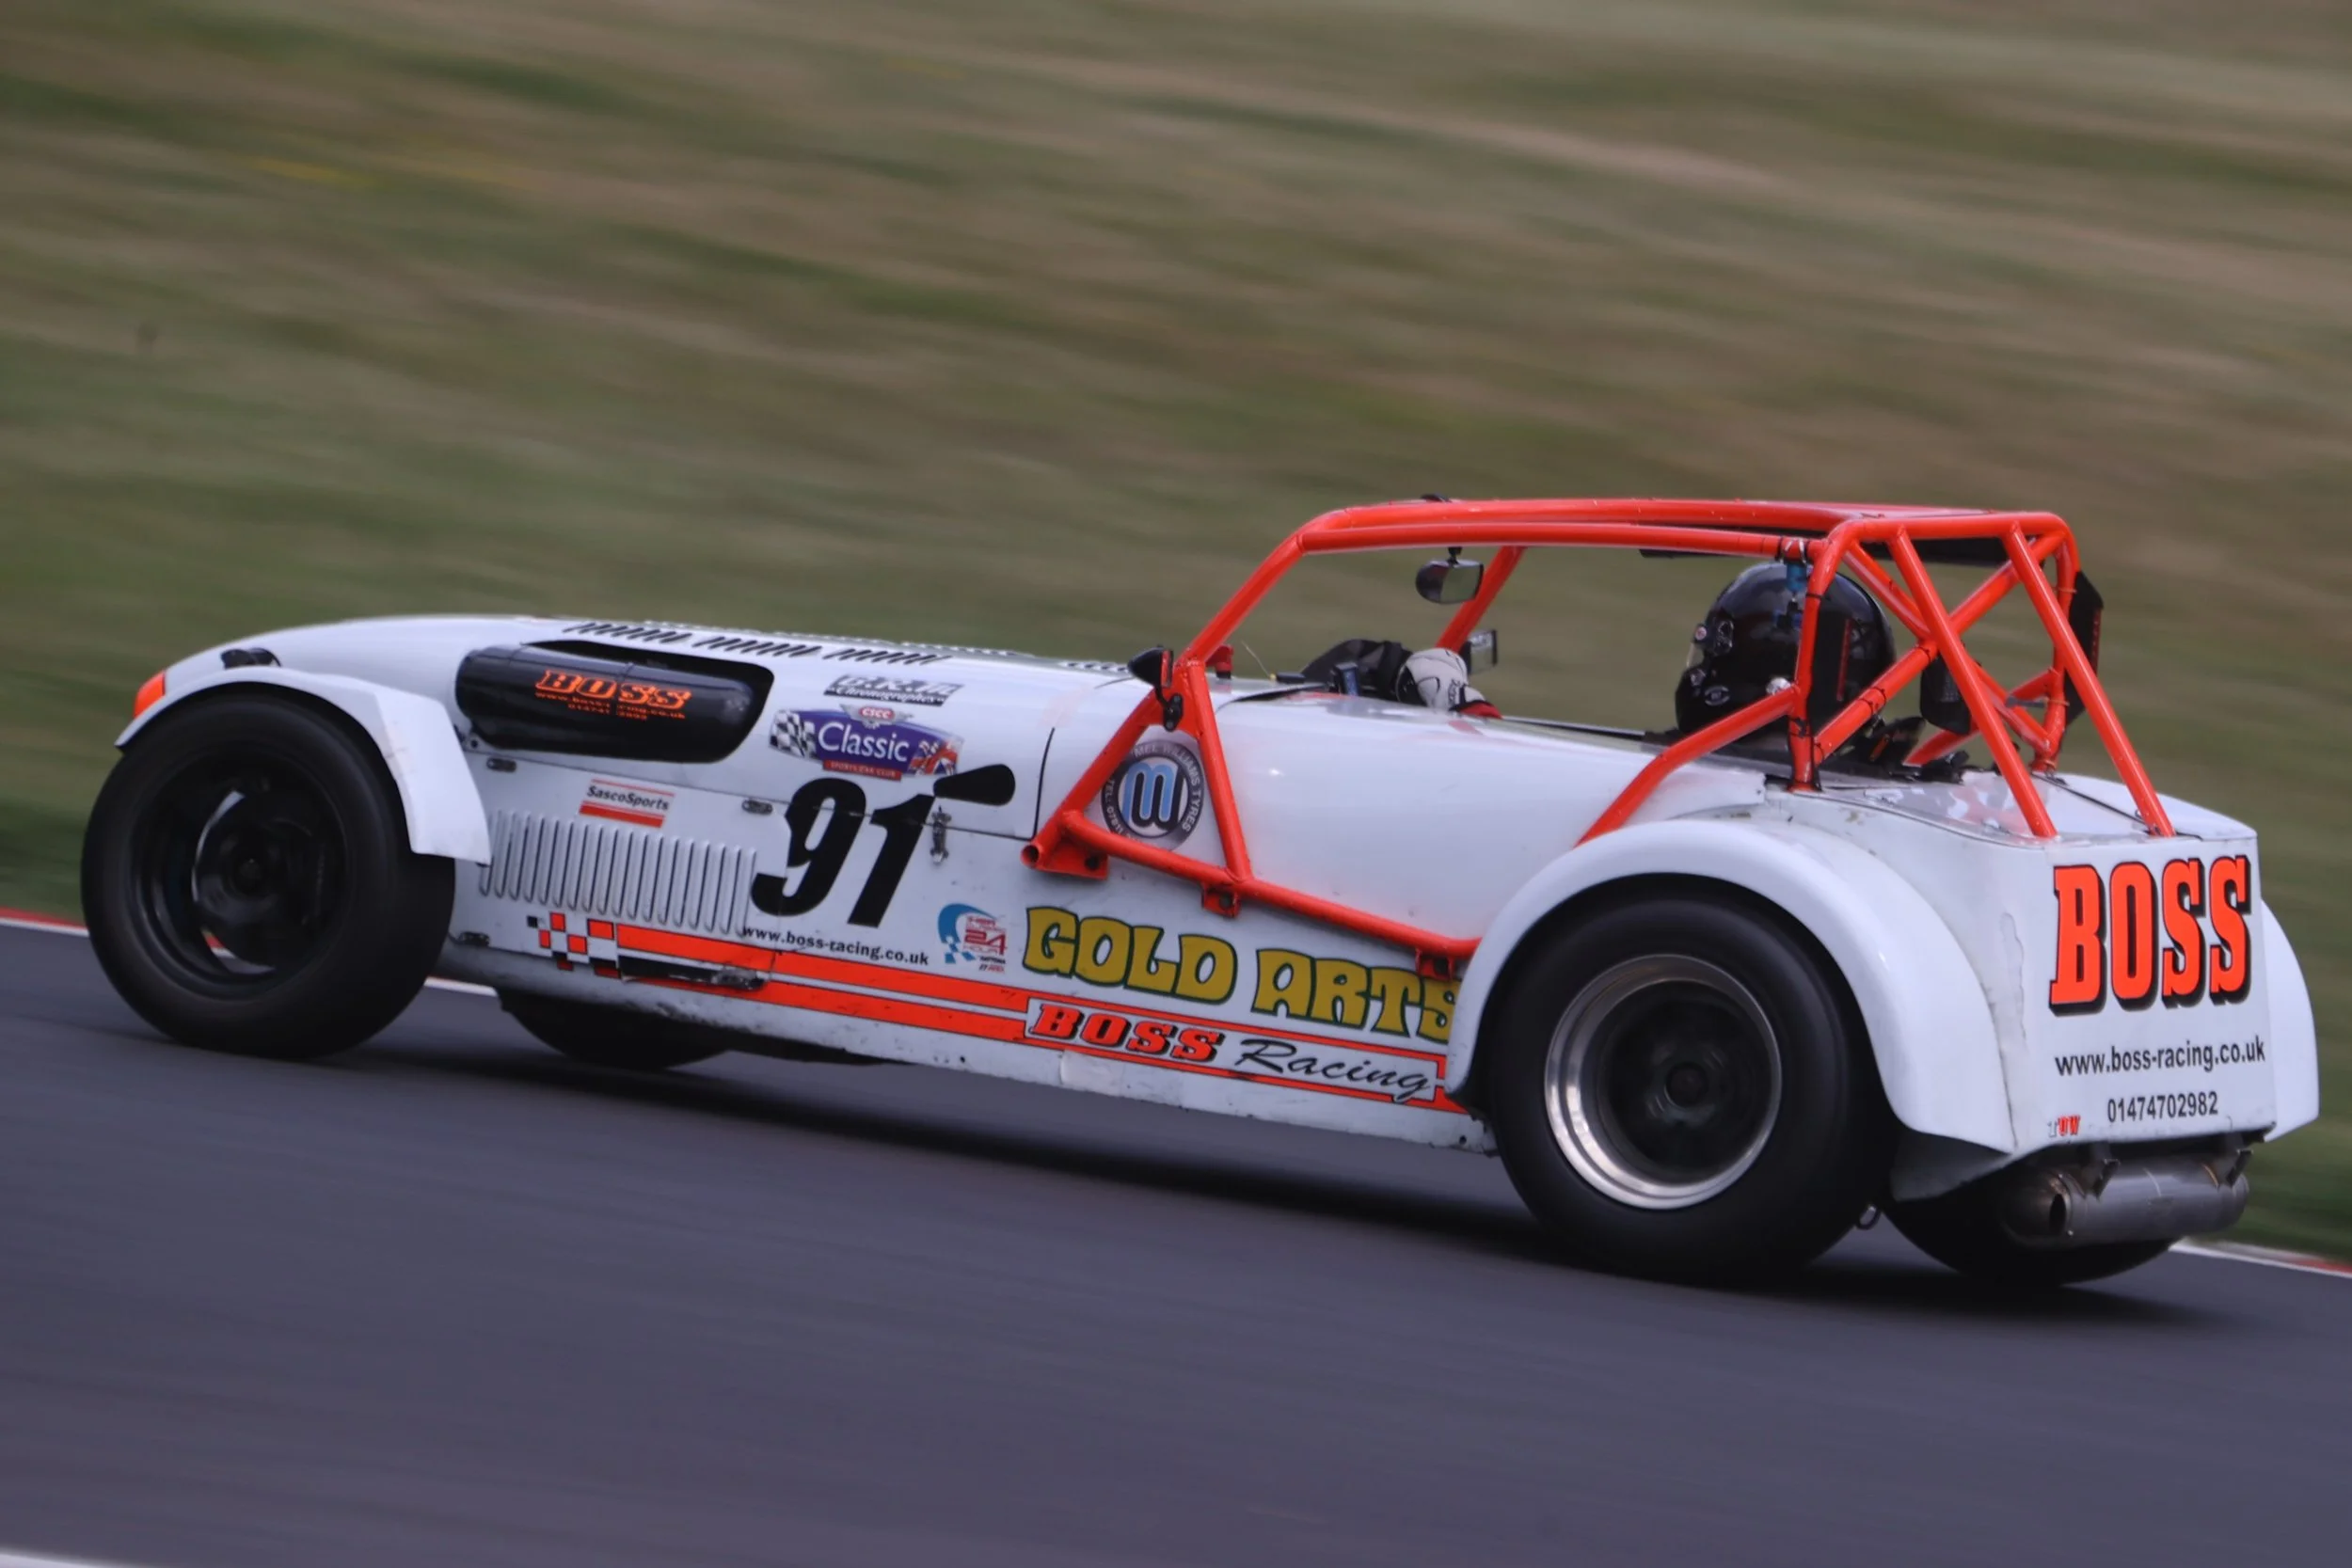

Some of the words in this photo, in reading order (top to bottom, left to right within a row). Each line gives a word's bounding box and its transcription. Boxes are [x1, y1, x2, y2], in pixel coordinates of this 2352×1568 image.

[535, 669, 692, 710] BOSS
[818, 721, 909, 762] Classic
[587, 785, 669, 810] SascoSports
[1182, 790, 1201, 832] TYRES
[751, 778, 937, 928] 91
[742, 926, 930, 965] www.boss-racing.co.uk
[963, 928, 1007, 956] 24
[2048, 855, 2252, 1017] BOSS
[1022, 906, 1238, 1005] GOLD
[1251, 948, 1463, 1046] ARTS
[1029, 1003, 1226, 1063] BOSS
[1234, 1037, 1431, 1102] Racing
[2055, 1036, 2266, 1076] www.boss-racing.co.uk
[2106, 1090, 2219, 1124] 01474702982
